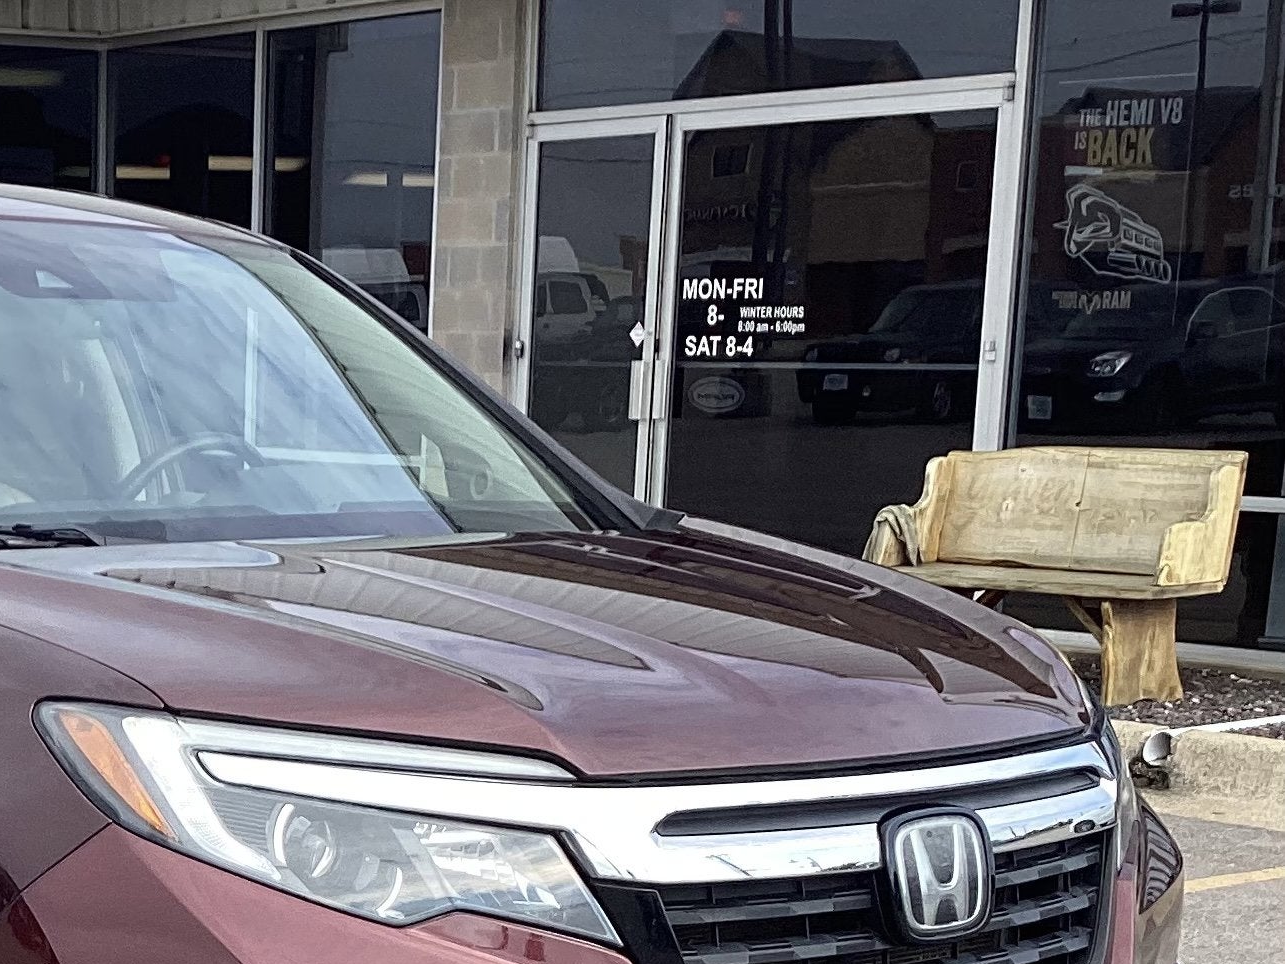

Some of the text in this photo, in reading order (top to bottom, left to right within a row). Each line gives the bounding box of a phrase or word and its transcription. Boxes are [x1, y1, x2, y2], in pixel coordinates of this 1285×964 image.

[1079, 98, 1183, 127] THE HEMI V8
[1074, 127, 1155, 166] IS BACK
[682, 277, 764, 300] MON-FRI
[1102, 290, 1131, 309] RAM
[739, 305, 805, 318] WINTER HOURS
[684, 335, 753, 357] SAT 8-4
